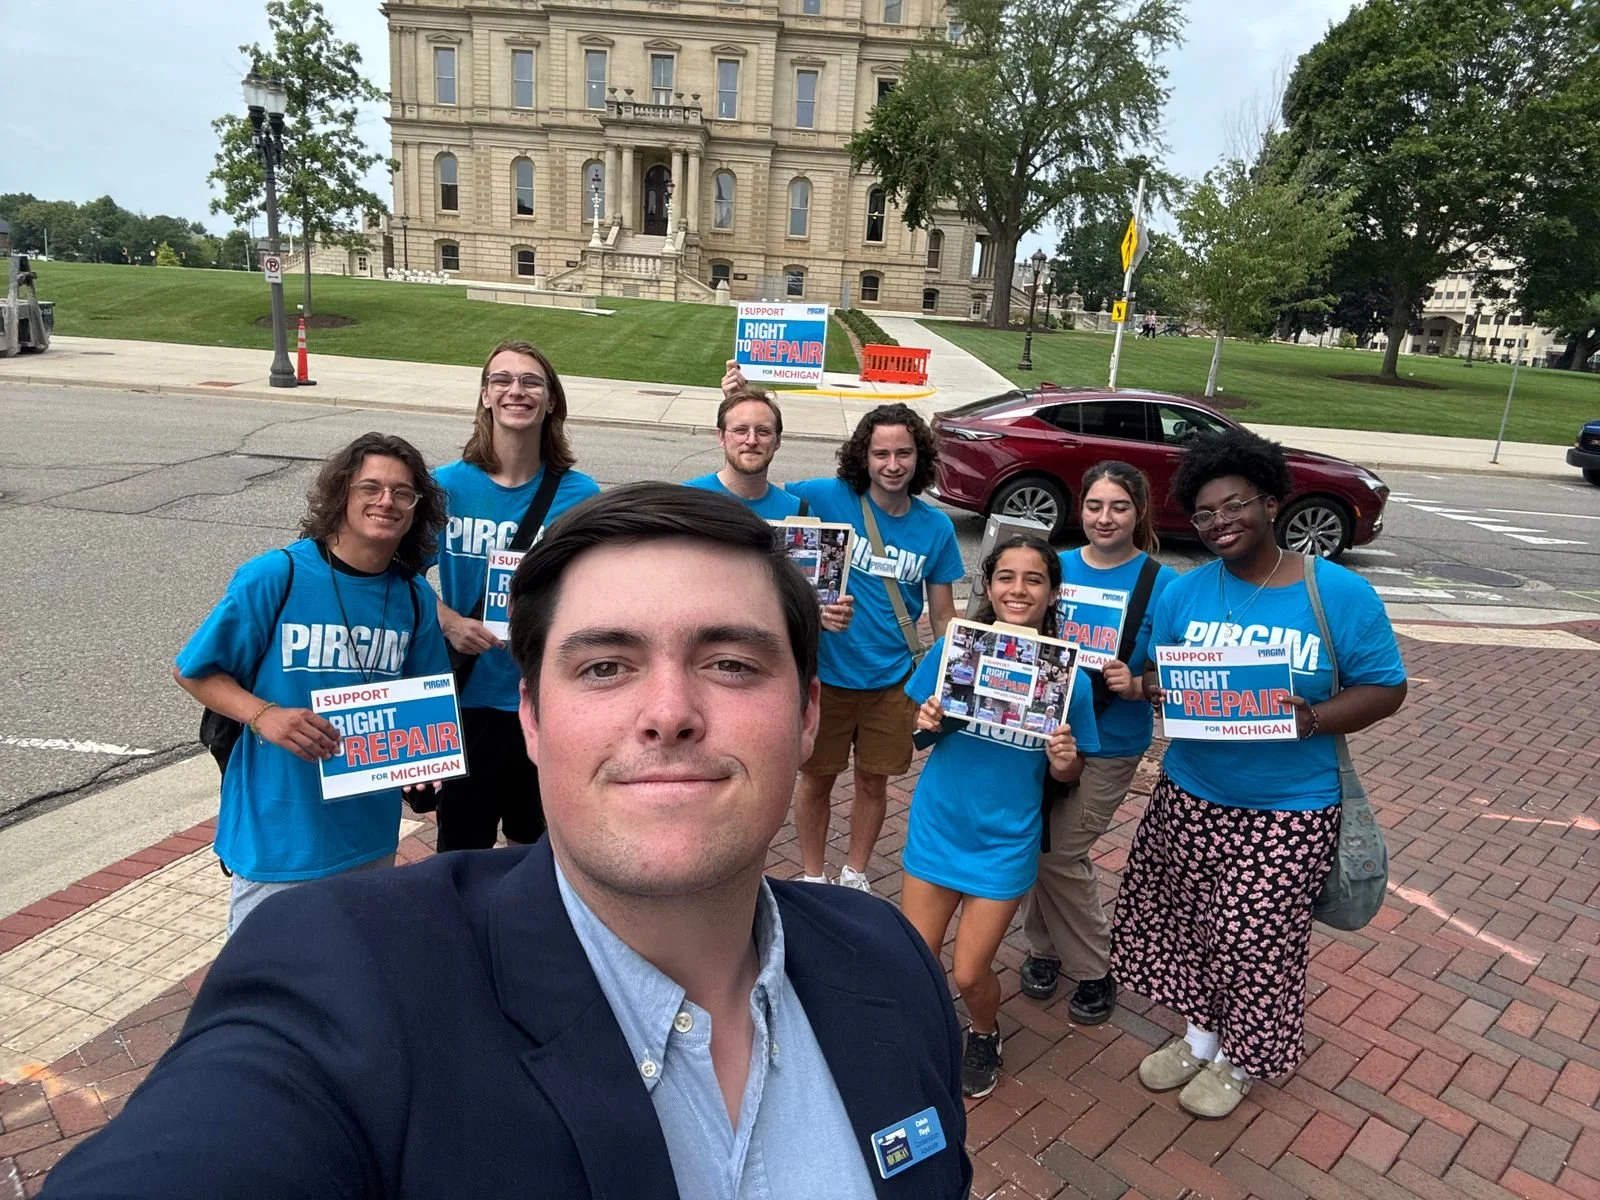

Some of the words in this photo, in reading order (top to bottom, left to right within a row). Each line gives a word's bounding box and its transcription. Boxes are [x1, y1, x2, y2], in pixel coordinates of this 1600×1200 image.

[745, 307, 784, 316] SUPPORT
[745, 322, 787, 340] RIGHT
[737, 339, 751, 352] TO
[750, 339, 823, 364] REPAIR
[774, 369, 819, 379] MICHIGAN
[446, 516, 545, 555] PIRG
[489, 592, 507, 608] TO
[1062, 621, 1118, 651] PAIR
[1184, 620, 1321, 671] PIRGIM
[282, 623, 410, 671] PIRGIM
[1166, 651, 1224, 662] SUPPORT
[1258, 648, 1286, 658] PIRGIM
[986, 667, 1010, 680] RIGHT
[1170, 669, 1230, 690] RIGHT
[424, 679, 450, 690] PIRGIM
[324, 688, 389, 706] SUPPORT
[1166, 689, 1182, 705] TO
[1182, 688, 1293, 717] REPAIR
[329, 707, 397, 737] RIGHT
[1222, 724, 1291, 735] MICHIGAN
[344, 722, 460, 767] REPAIR
[371, 772, 388, 781] FOR
[390, 759, 460, 781] MICHIGAN
